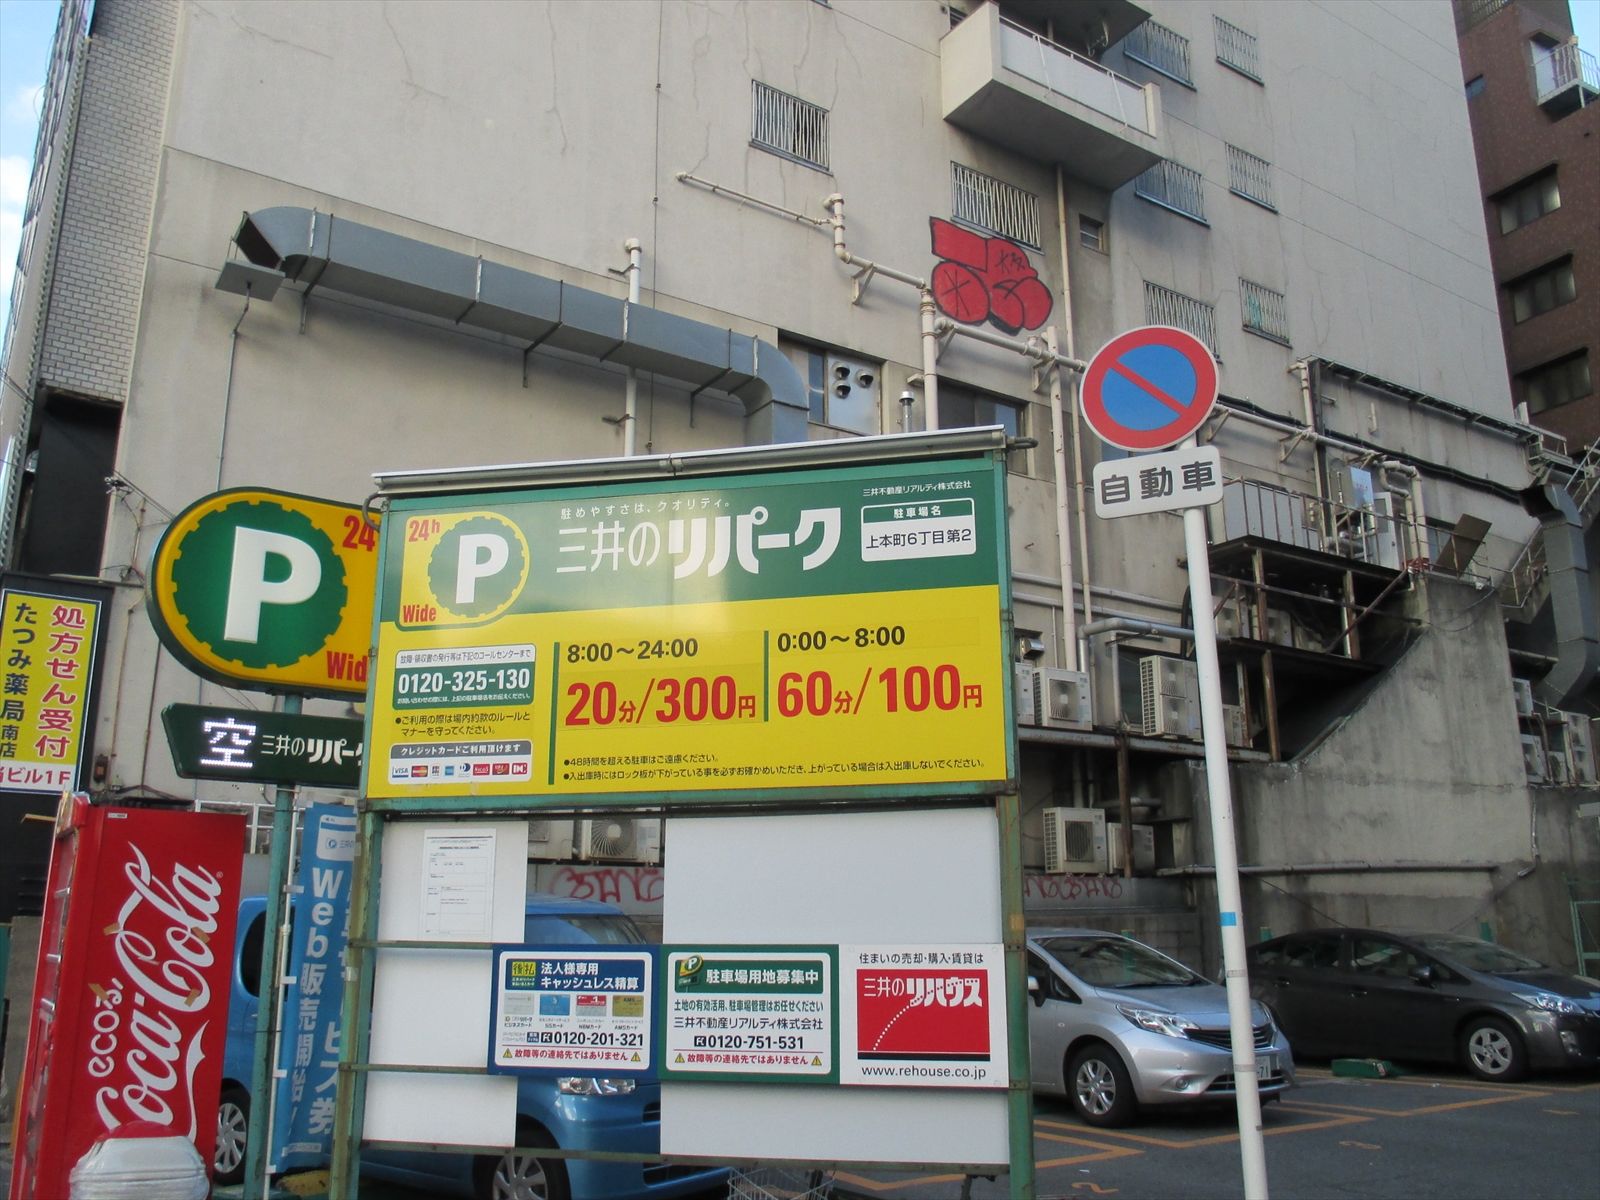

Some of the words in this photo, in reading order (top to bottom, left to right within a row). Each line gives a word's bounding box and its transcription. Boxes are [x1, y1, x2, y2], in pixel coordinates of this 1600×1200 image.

[863, 480, 972, 496] 三井不動産リアルティ株式会社
[1100, 461, 1216, 504] 自動車
[560, 498, 731, 520] 駐めやすさは、クオリティ。
[894, 506, 941, 519] 駐車場名
[408, 520, 440, 542] 24h
[866, 529, 972, 549] 上本町6丁目第2
[556, 506, 841, 579] 三井のリパーク
[456, 533, 509, 604] P
[224, 526, 321, 643] P
[403, 605, 437, 623] Wide
[778, 626, 905, 652] 0:00～8:00
[567, 638, 698, 663] 8:00～24:00
[0, 603, 37, 758] たつみ薬局南店
[35, 605, 86, 758] 処方せん受付
[398, 668, 530, 694] 0120-325-130
[401, 726, 496, 736] マナーを守ってください。
[201, 718, 256, 768] 空
[401, 744, 521, 756] クレジットカードご利用頂けます
[859, 953, 984, 964] 住まいの売却・購入・賃貸は
[541, 962, 599, 975] 法人様専用
[706, 969, 819, 984] 駐車場用地募集中
[541, 976, 639, 990] キャッシュレス精算
[864, 976, 983, 1008] 三井のリハウス
[674, 999, 824, 1012] 土地の有効活用、駐車場管理はお任せください
[674, 1016, 824, 1030] 三井不動産リアルティ株式会社
[553, 1032, 644, 1047] 0120-201-321
[708, 1035, 804, 1050] 0120-751-531
[514, 1049, 629, 1061] 故障等の連絡先ではありません
[687, 1053, 809, 1065] 故障等の連絡先ではありません
[861, 1065, 986, 1080] www.rehouse.co.jp
